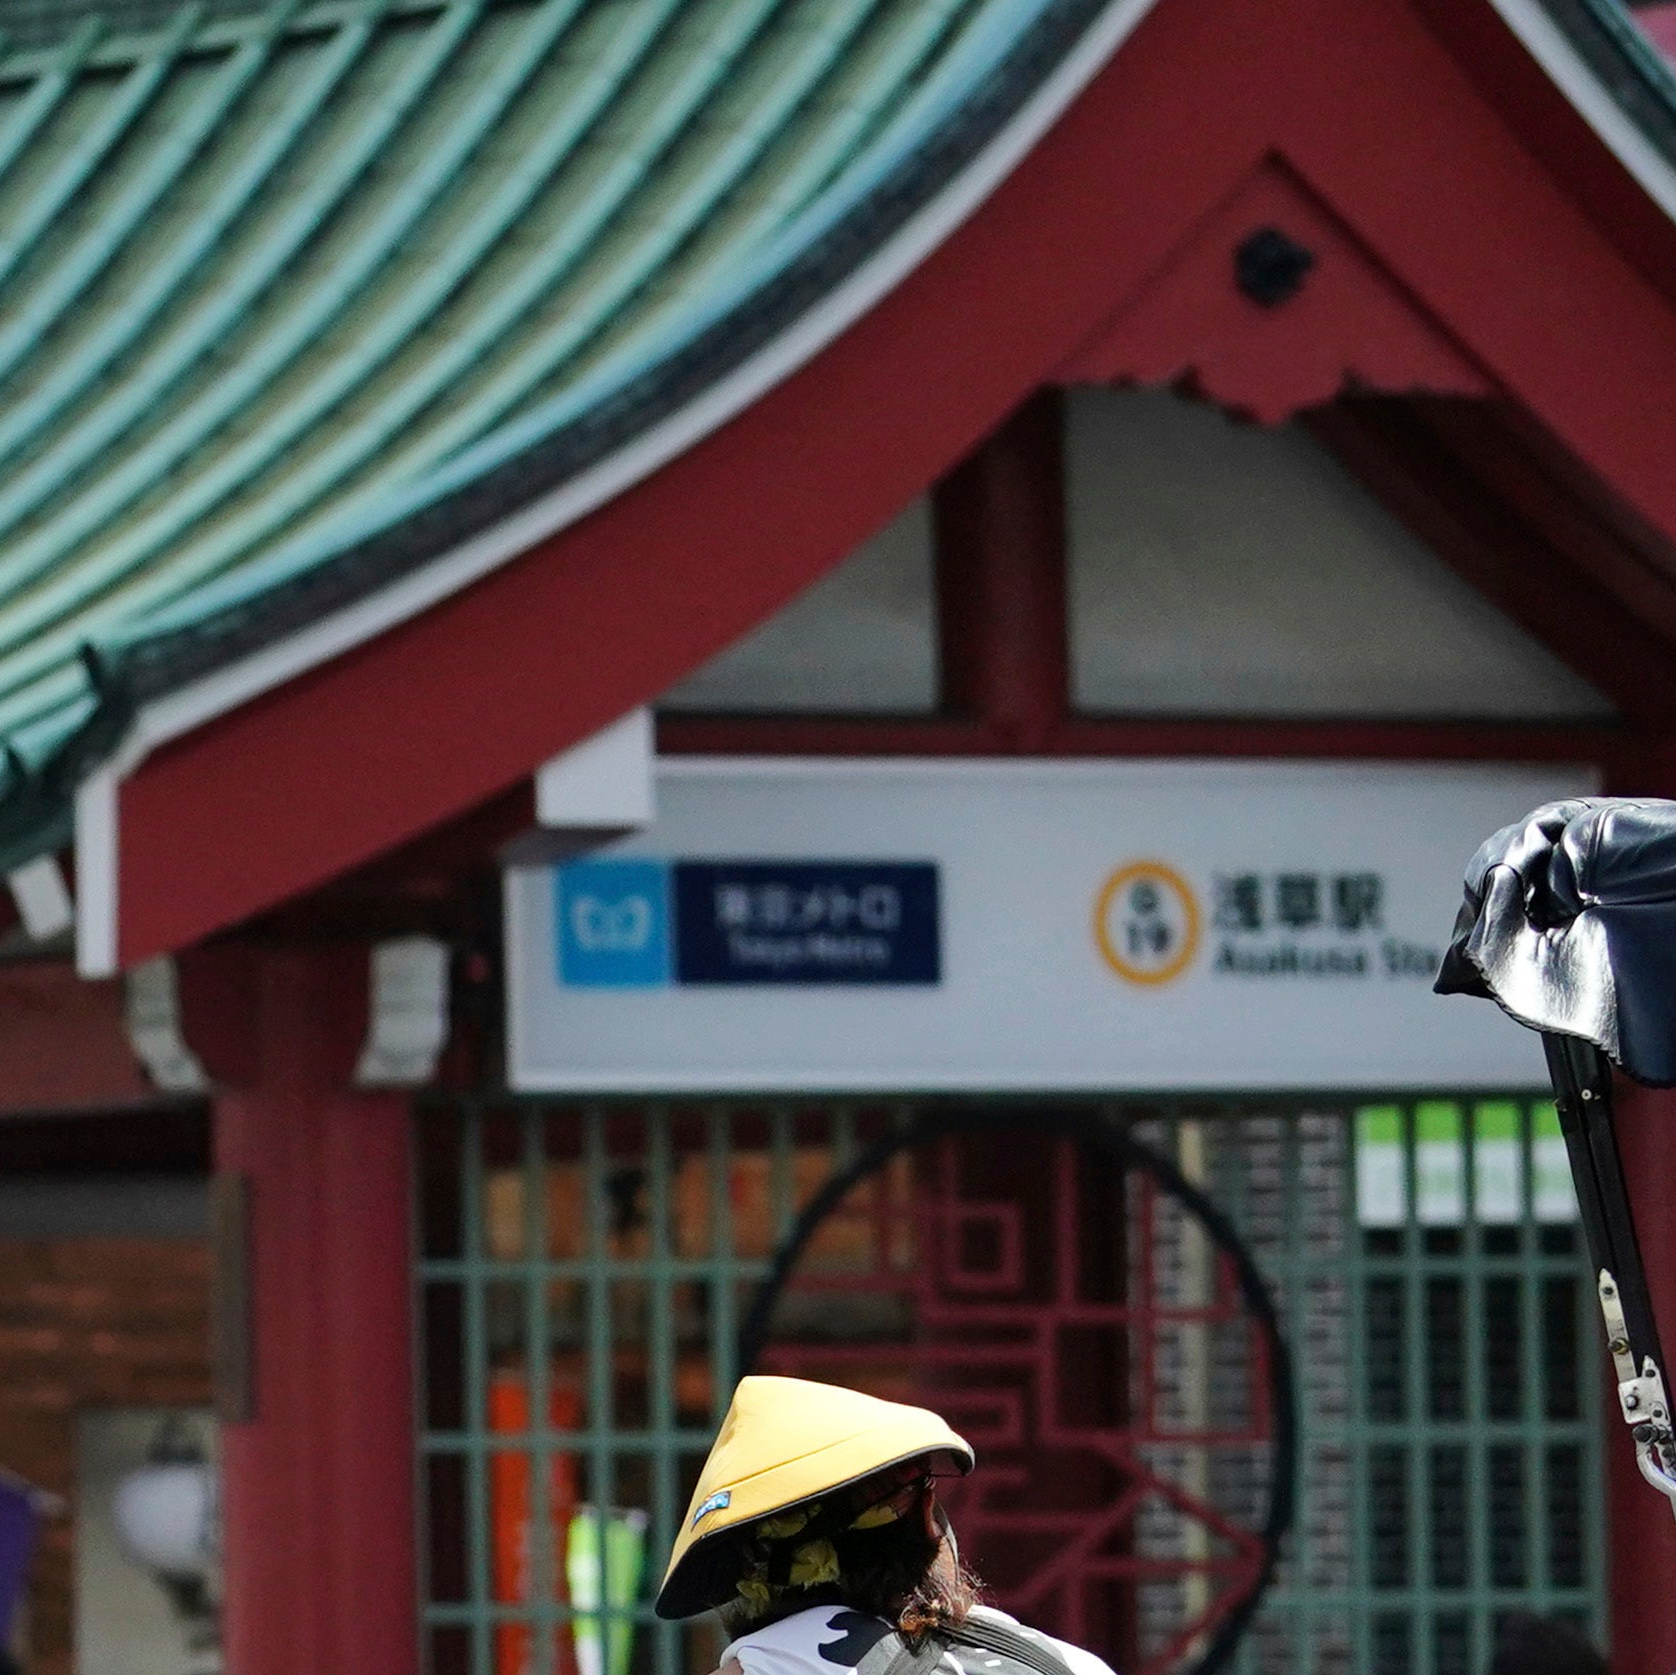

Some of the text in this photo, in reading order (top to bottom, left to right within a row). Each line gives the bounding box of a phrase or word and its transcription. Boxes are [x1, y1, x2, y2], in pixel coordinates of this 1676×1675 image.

[1211, 872, 1383, 932] 浅草駅
[1214, 941, 1367, 975] Asakusa
